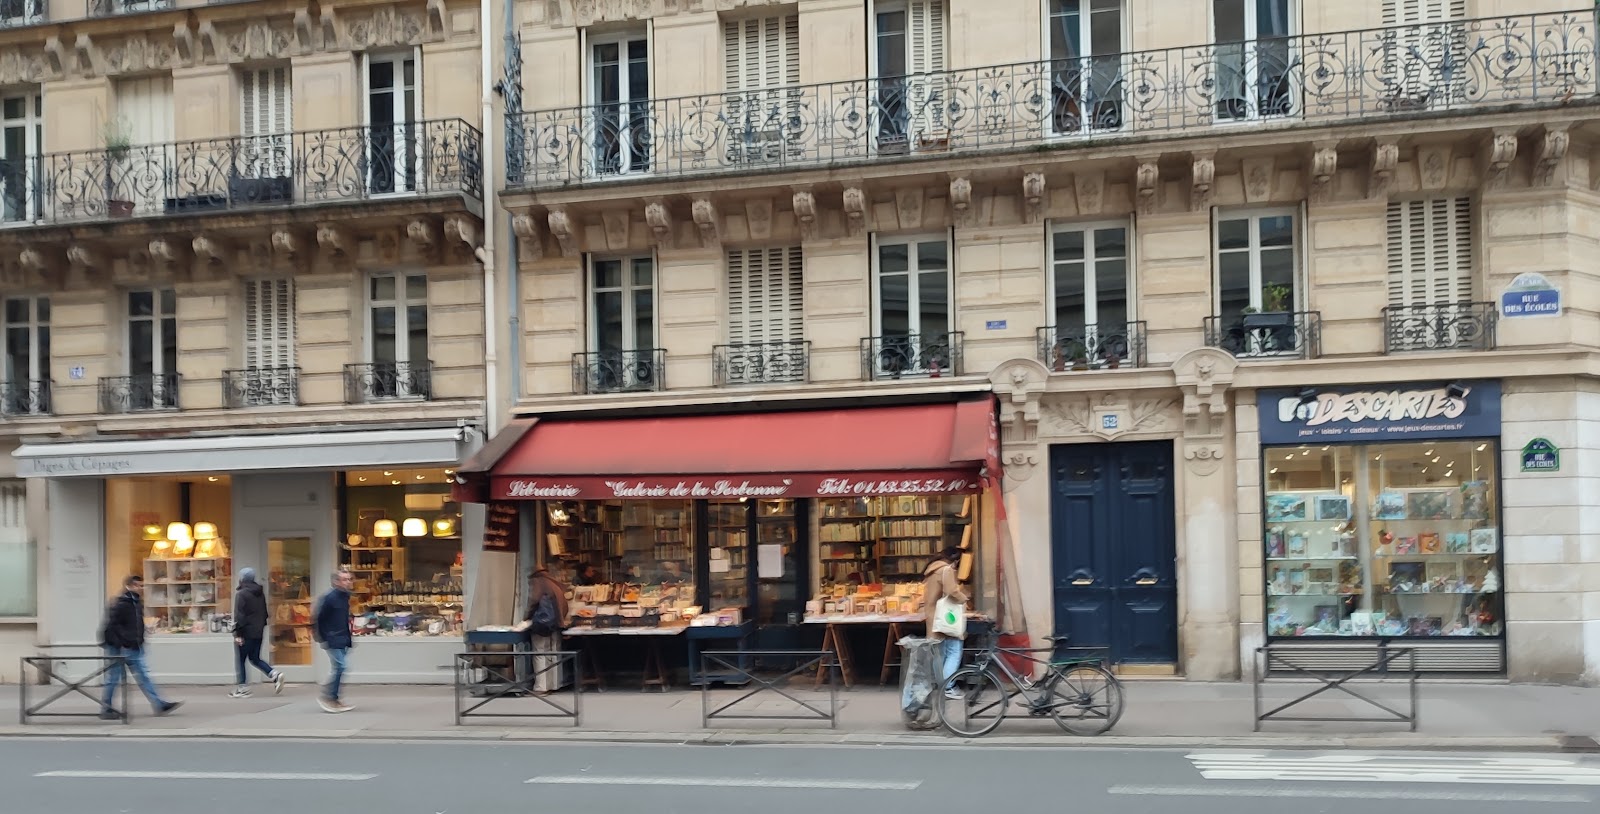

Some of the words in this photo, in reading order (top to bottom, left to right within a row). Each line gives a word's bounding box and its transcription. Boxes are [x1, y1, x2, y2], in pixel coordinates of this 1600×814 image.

[1521, 295, 1539, 303] RUE
[1504, 305, 1522, 313] DES
[1306, 387, 1471, 426] DESCARTES
[1104, 416, 1117, 427] 52
[1298, 429, 1314, 437] jeux
[1321, 427, 1342, 435] loisirs
[1349, 426, 1379, 434] cadeaux
[67, 457, 78, 471] &
[506, 480, 582, 497] Librairie
[669, 481, 691, 496] de
[691, 481, 711, 496] la
